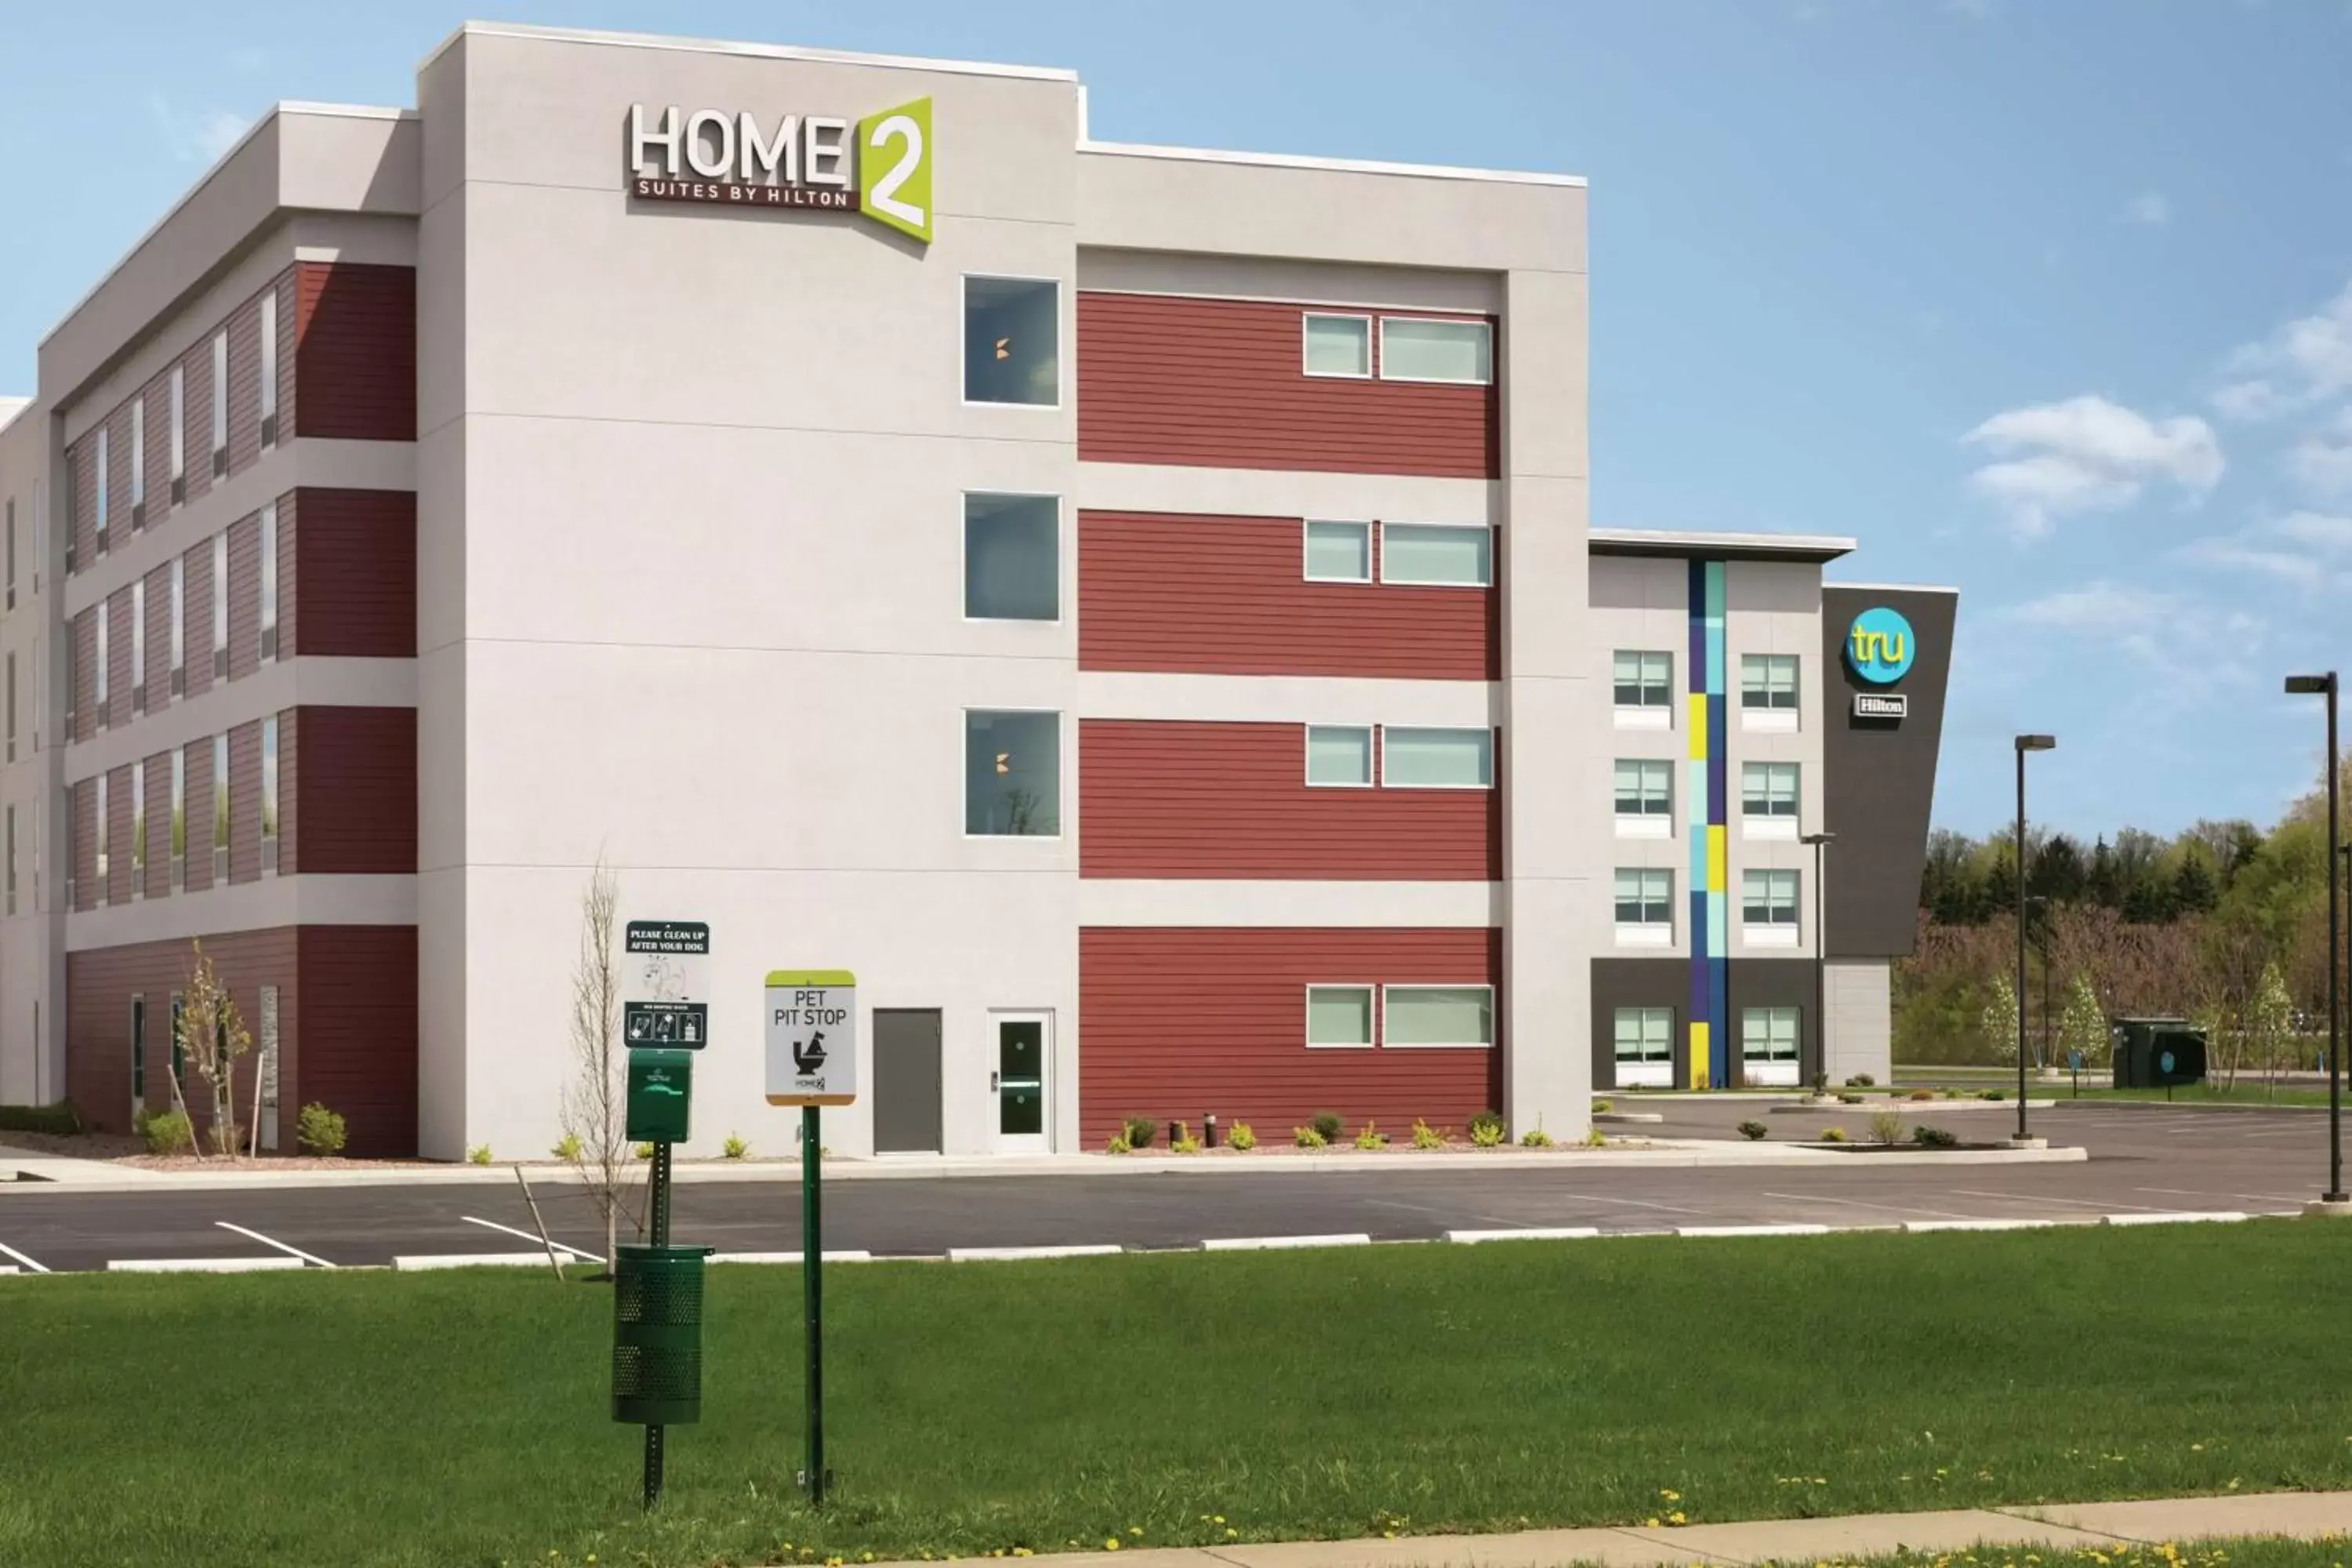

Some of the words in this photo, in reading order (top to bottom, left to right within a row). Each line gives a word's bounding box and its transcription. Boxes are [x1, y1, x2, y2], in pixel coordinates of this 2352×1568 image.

[631, 103, 848, 185] HOME
[869, 114, 925, 228] 2
[638, 180, 719, 199] SUITES
[730, 186, 757, 201] BY
[767, 189, 848, 207] HILTON
[1850, 624, 1904, 663] tru
[1860, 698, 1903, 713] Hilton
[663, 931, 691, 940] CLEAN
[692, 931, 706, 940] UP
[631, 942, 658, 950] AFTER
[659, 942, 683, 951] YOUR
[684, 942, 703, 951] DOG
[795, 990, 827, 1007] PET
[775, 1009, 800, 1025] PIT
[804, 1009, 847, 1025] STOP
